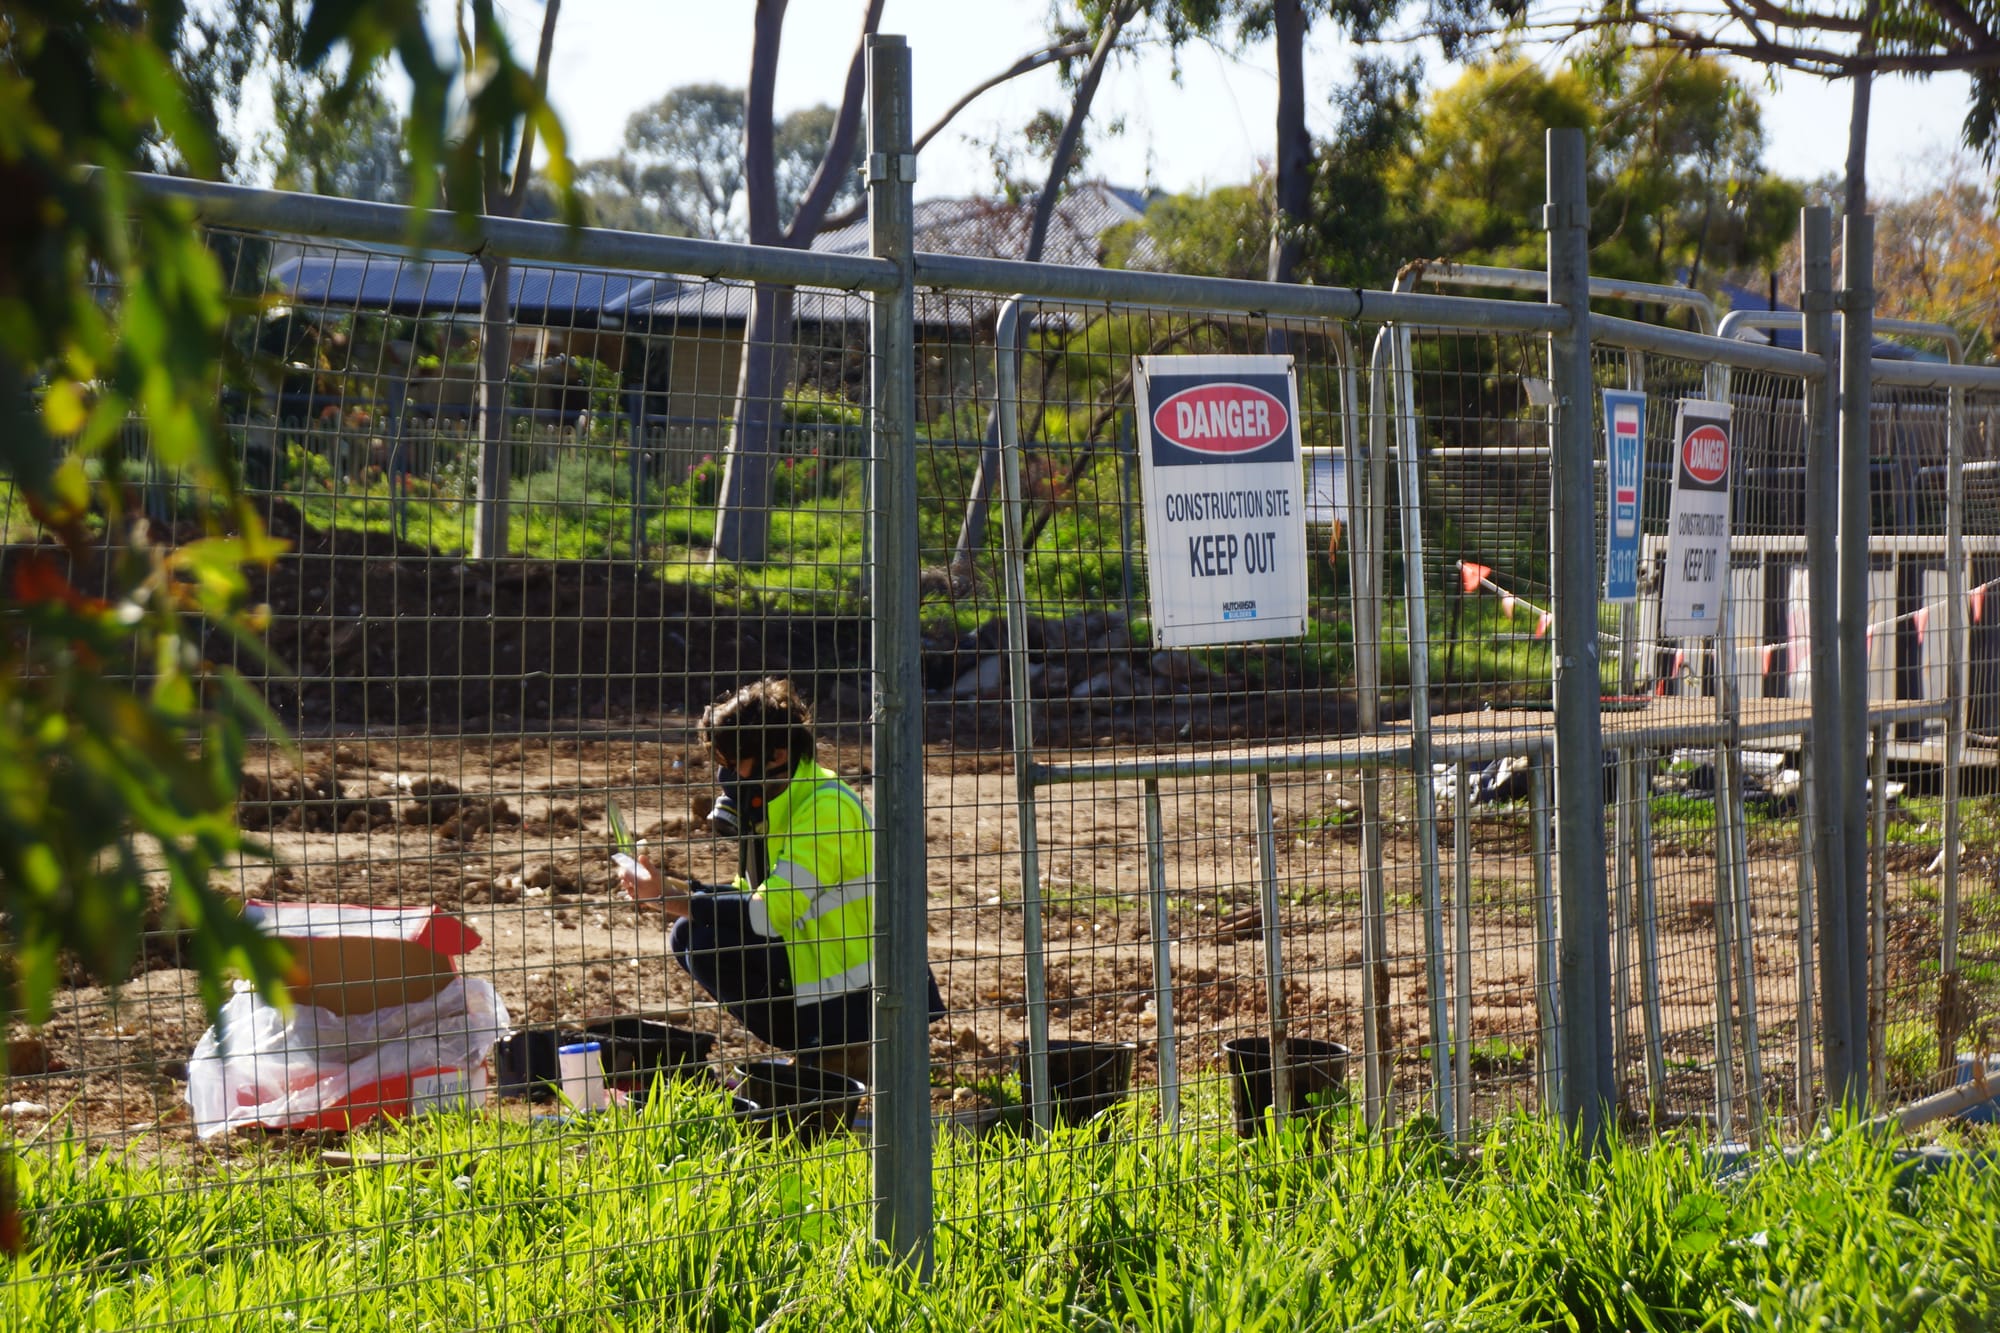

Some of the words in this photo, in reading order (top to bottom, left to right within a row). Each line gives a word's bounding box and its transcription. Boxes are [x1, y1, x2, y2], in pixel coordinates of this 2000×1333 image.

[1176, 399, 1271, 439] DANGER
[1690, 437, 1725, 471] DANGER
[1166, 490, 1263, 522] CONSTRUCTION
[1265, 489, 1290, 517] SITE
[1679, 512, 1716, 536] CONSTRUCTION
[1189, 534, 1238, 577] KEEP
[1244, 532, 1276, 575] OUT
[1683, 548, 1703, 582] KEEP
[1704, 548, 1717, 582] OUT
